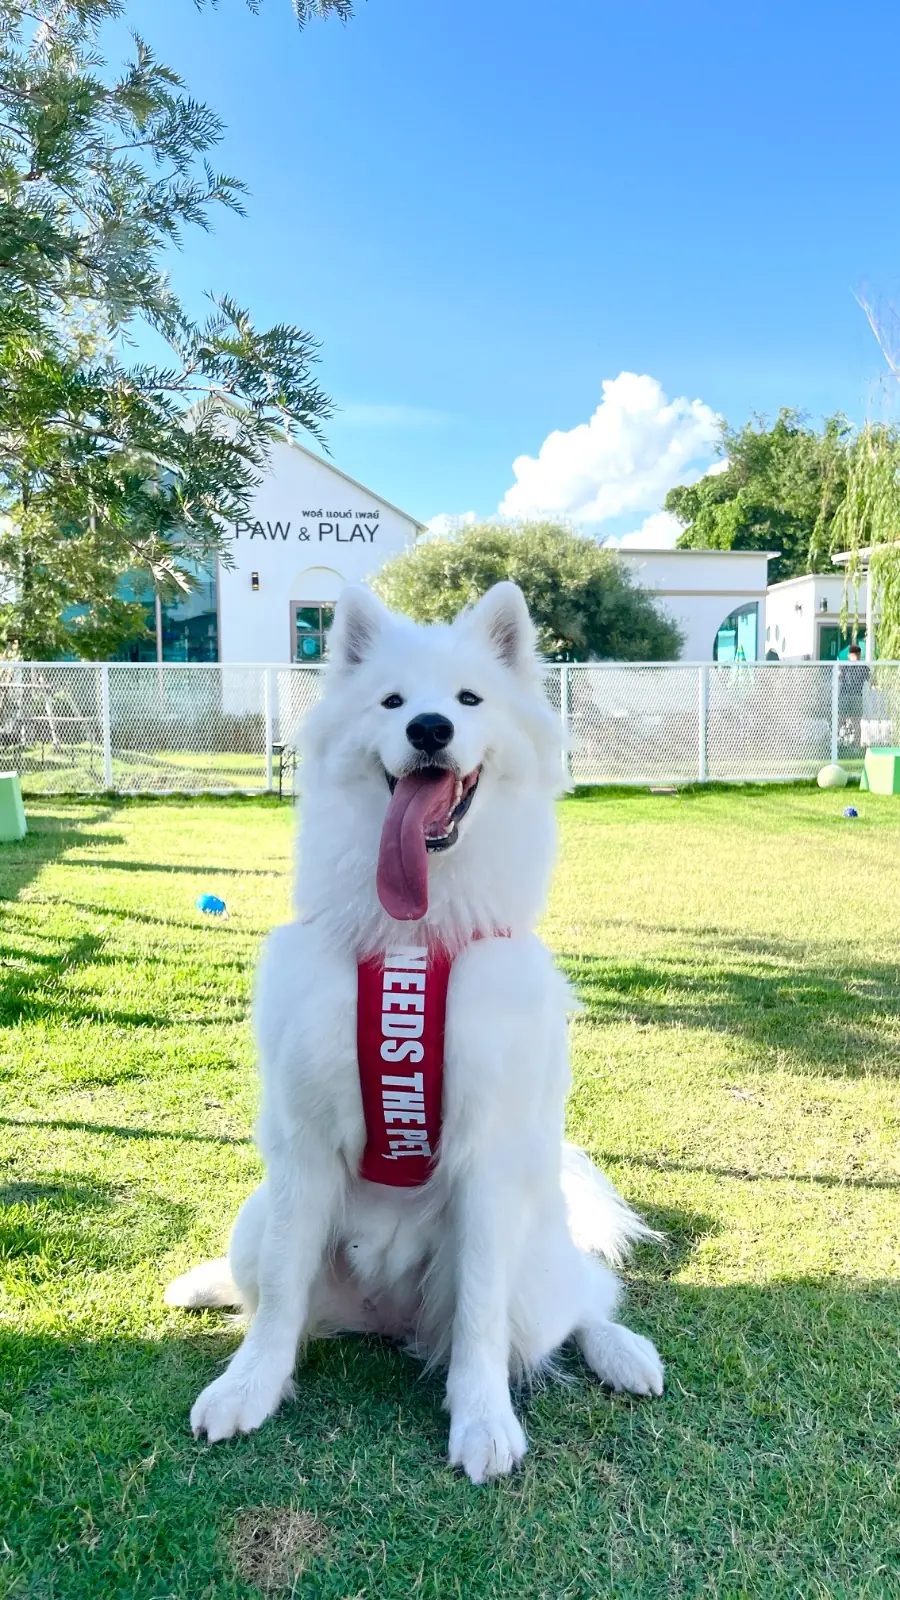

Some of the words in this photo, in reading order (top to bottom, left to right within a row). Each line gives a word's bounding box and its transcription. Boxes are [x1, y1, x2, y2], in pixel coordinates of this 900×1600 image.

[326, 509, 352, 519] แอนด์
[355, 510, 380, 520] เพลย์
[235, 521, 291, 541] PAW
[298, 526, 311, 542] &
[319, 522, 380, 543] PLAY
[380, 946, 427, 1063] NEEDS
[381, 1072, 426, 1124] THE
[381, 1128, 432, 1160] PET,
